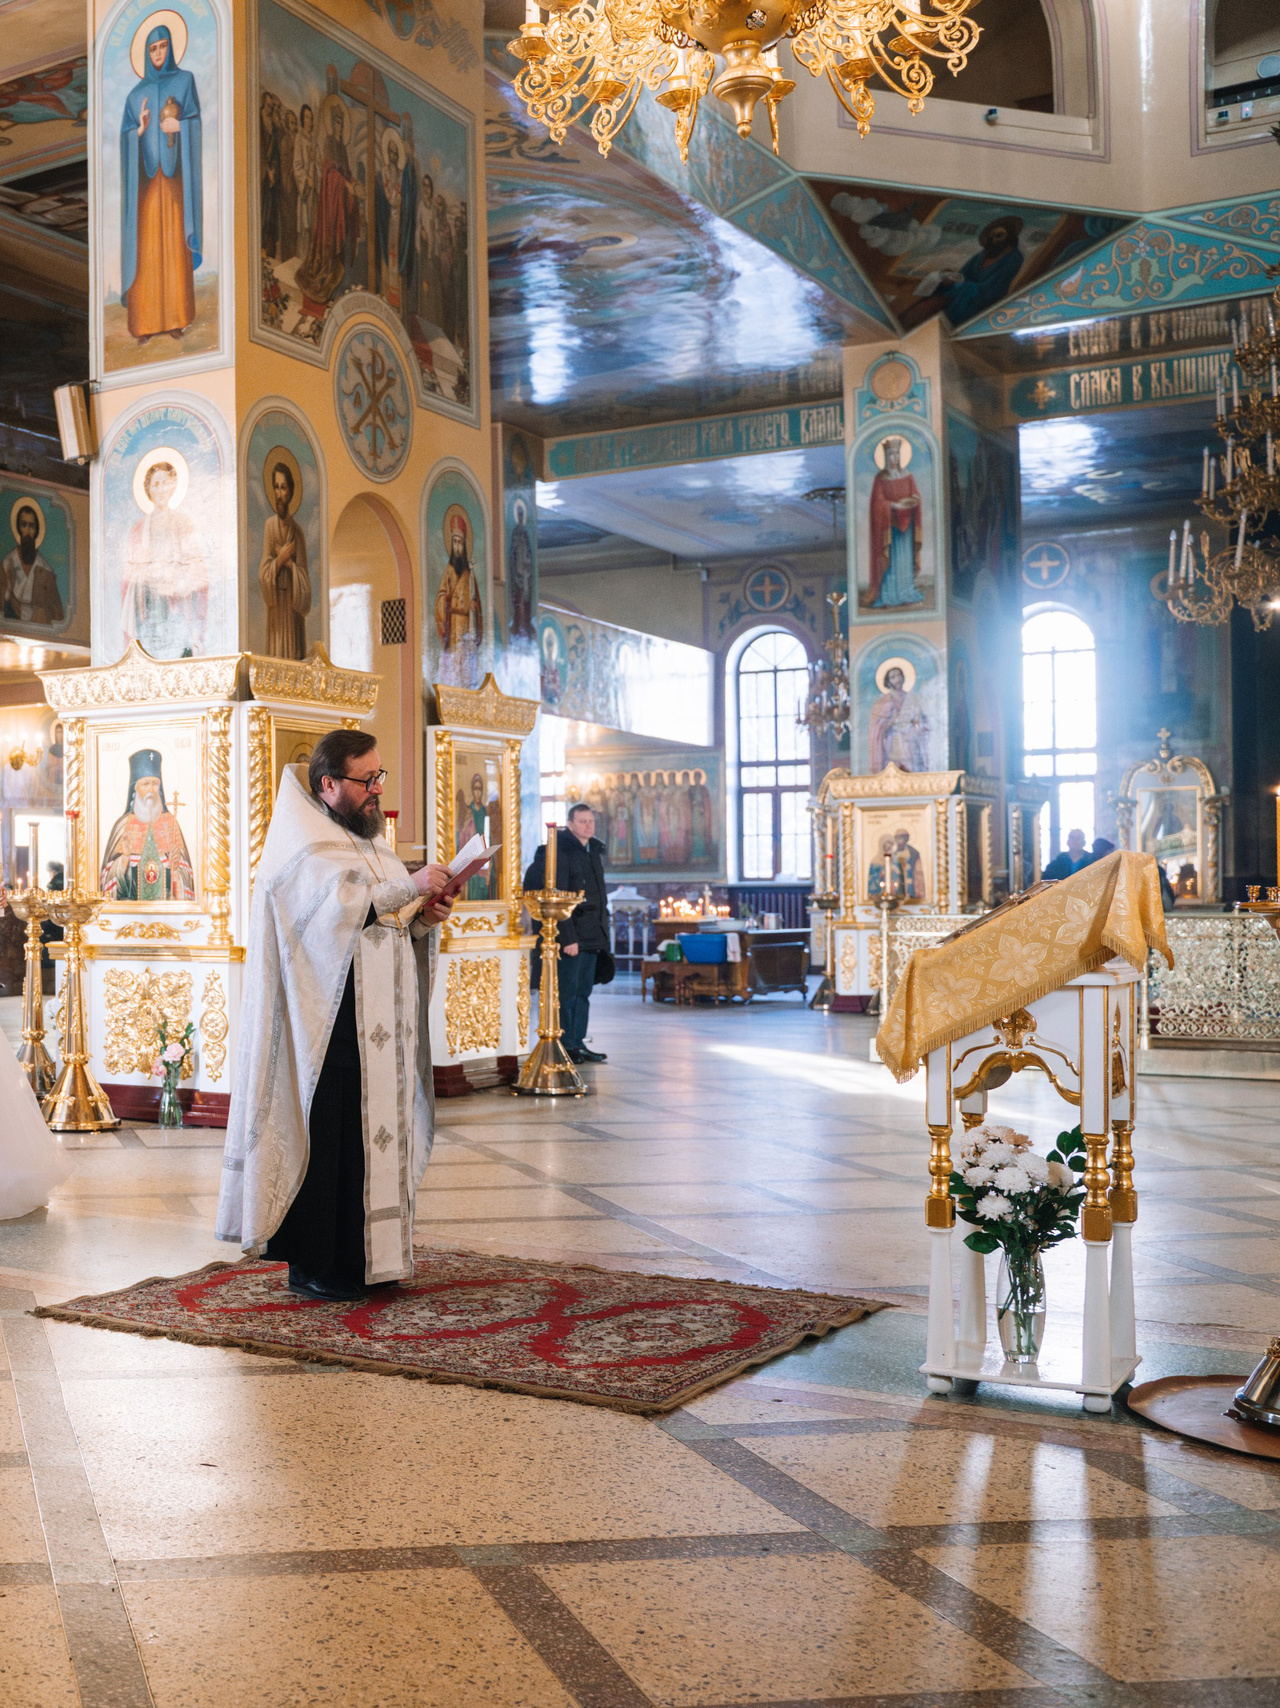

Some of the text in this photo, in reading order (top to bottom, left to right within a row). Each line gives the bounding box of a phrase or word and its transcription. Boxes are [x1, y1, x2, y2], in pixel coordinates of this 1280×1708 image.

[1070, 367, 1121, 410] СЛАВА
[1132, 364, 1143, 401] В
[1150, 352, 1230, 399] ВЫШНИХ
